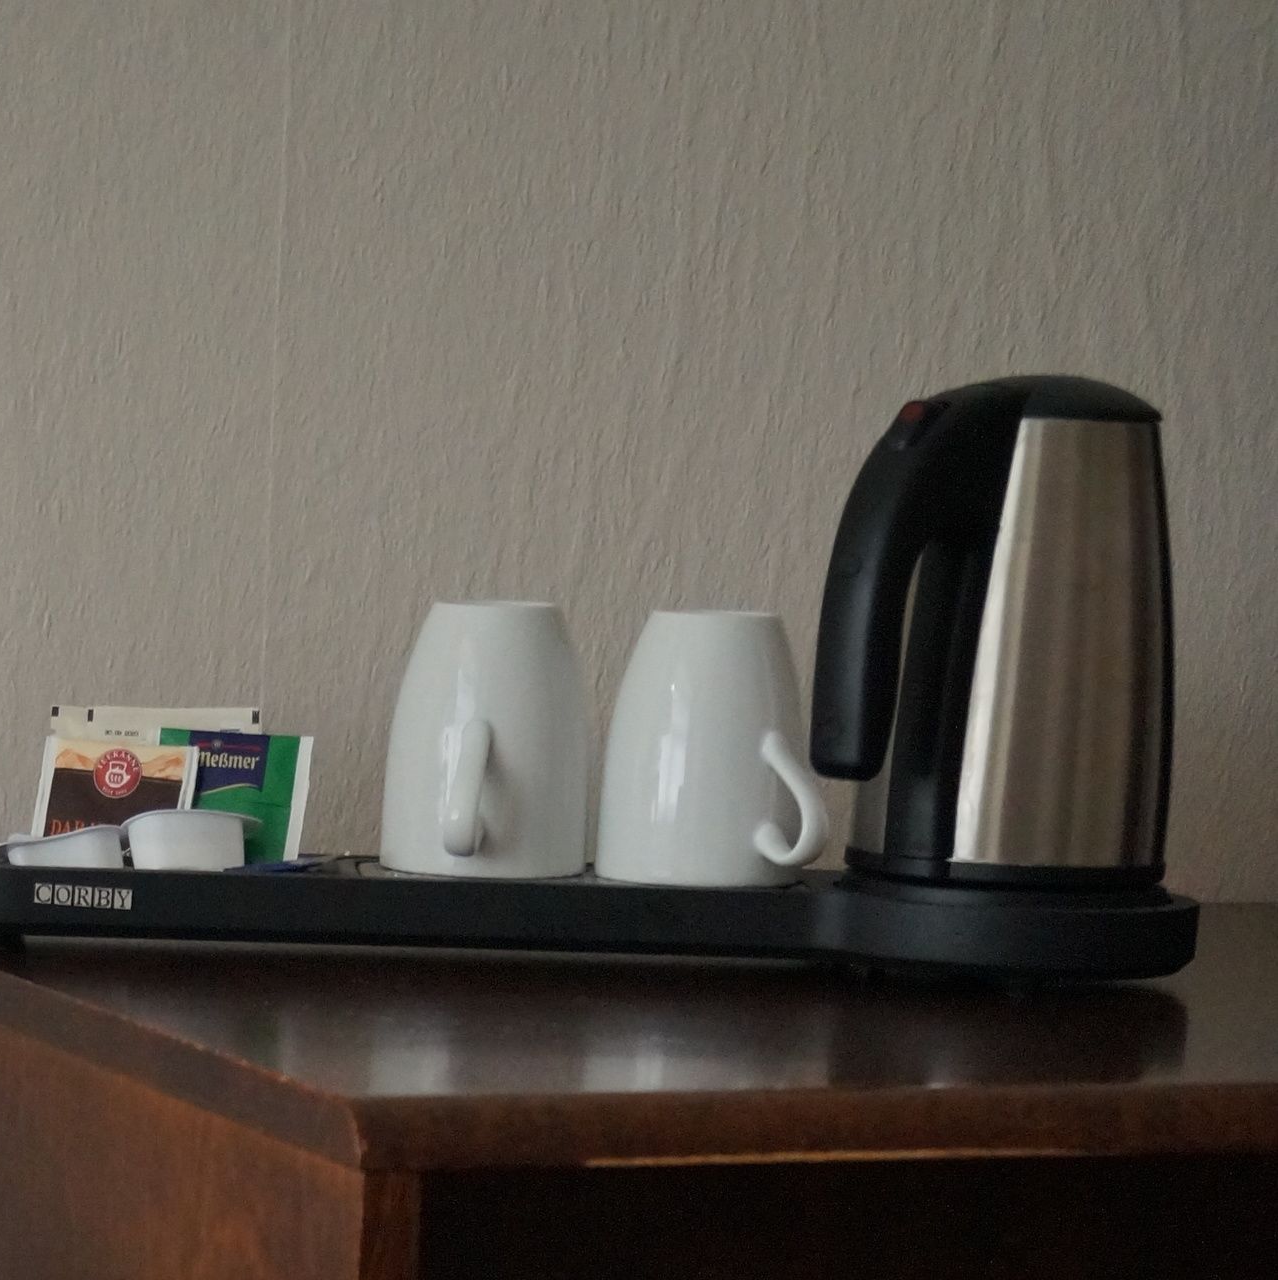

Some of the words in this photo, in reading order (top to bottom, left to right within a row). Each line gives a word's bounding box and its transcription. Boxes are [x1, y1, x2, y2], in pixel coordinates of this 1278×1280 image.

[198, 751, 261, 770] Meßmer
[50, 819, 95, 835] DAR
[35, 882, 132, 910] CORBY
